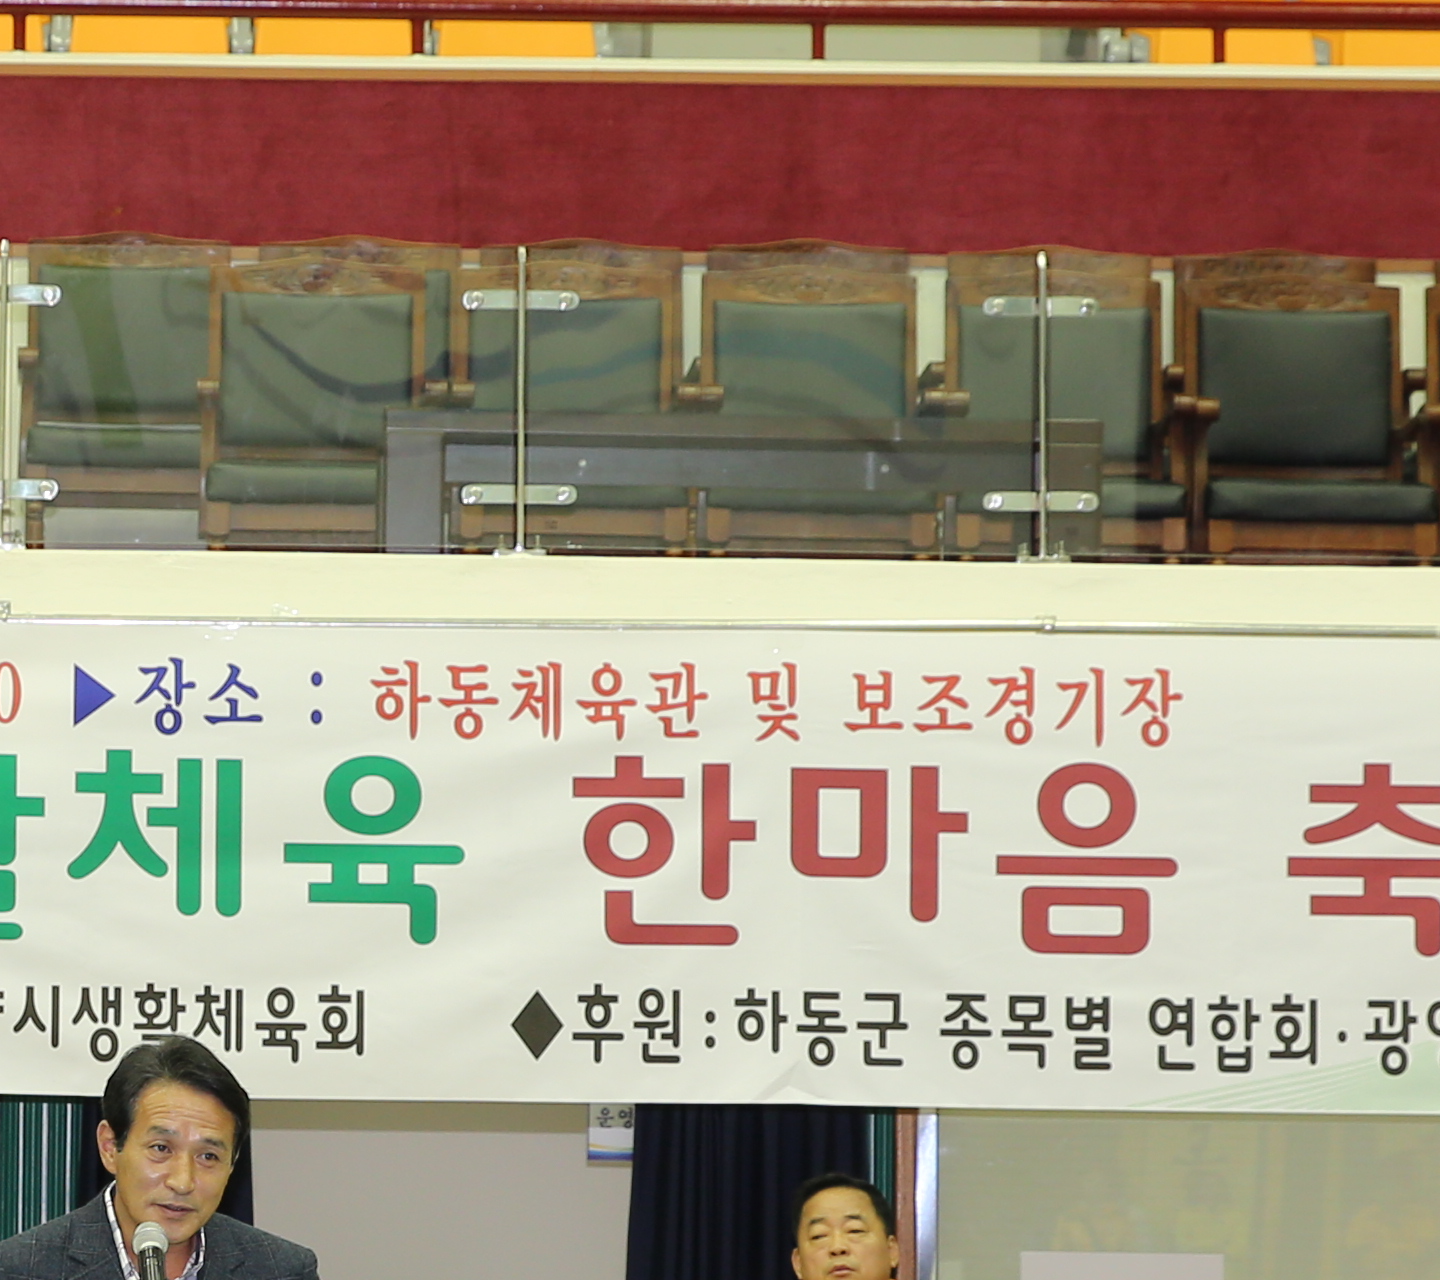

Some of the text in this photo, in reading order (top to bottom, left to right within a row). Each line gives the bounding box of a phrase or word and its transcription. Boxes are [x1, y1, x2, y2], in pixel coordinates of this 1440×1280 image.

[134, 656, 263, 736] 장소
[371, 660, 708, 741] 하동체육관
[747, 662, 800, 741] 및
[844, 666, 1183, 748] 보조경기장
[571, 754, 1179, 956] 한마음
[940, 993, 1113, 1071] 종목별
